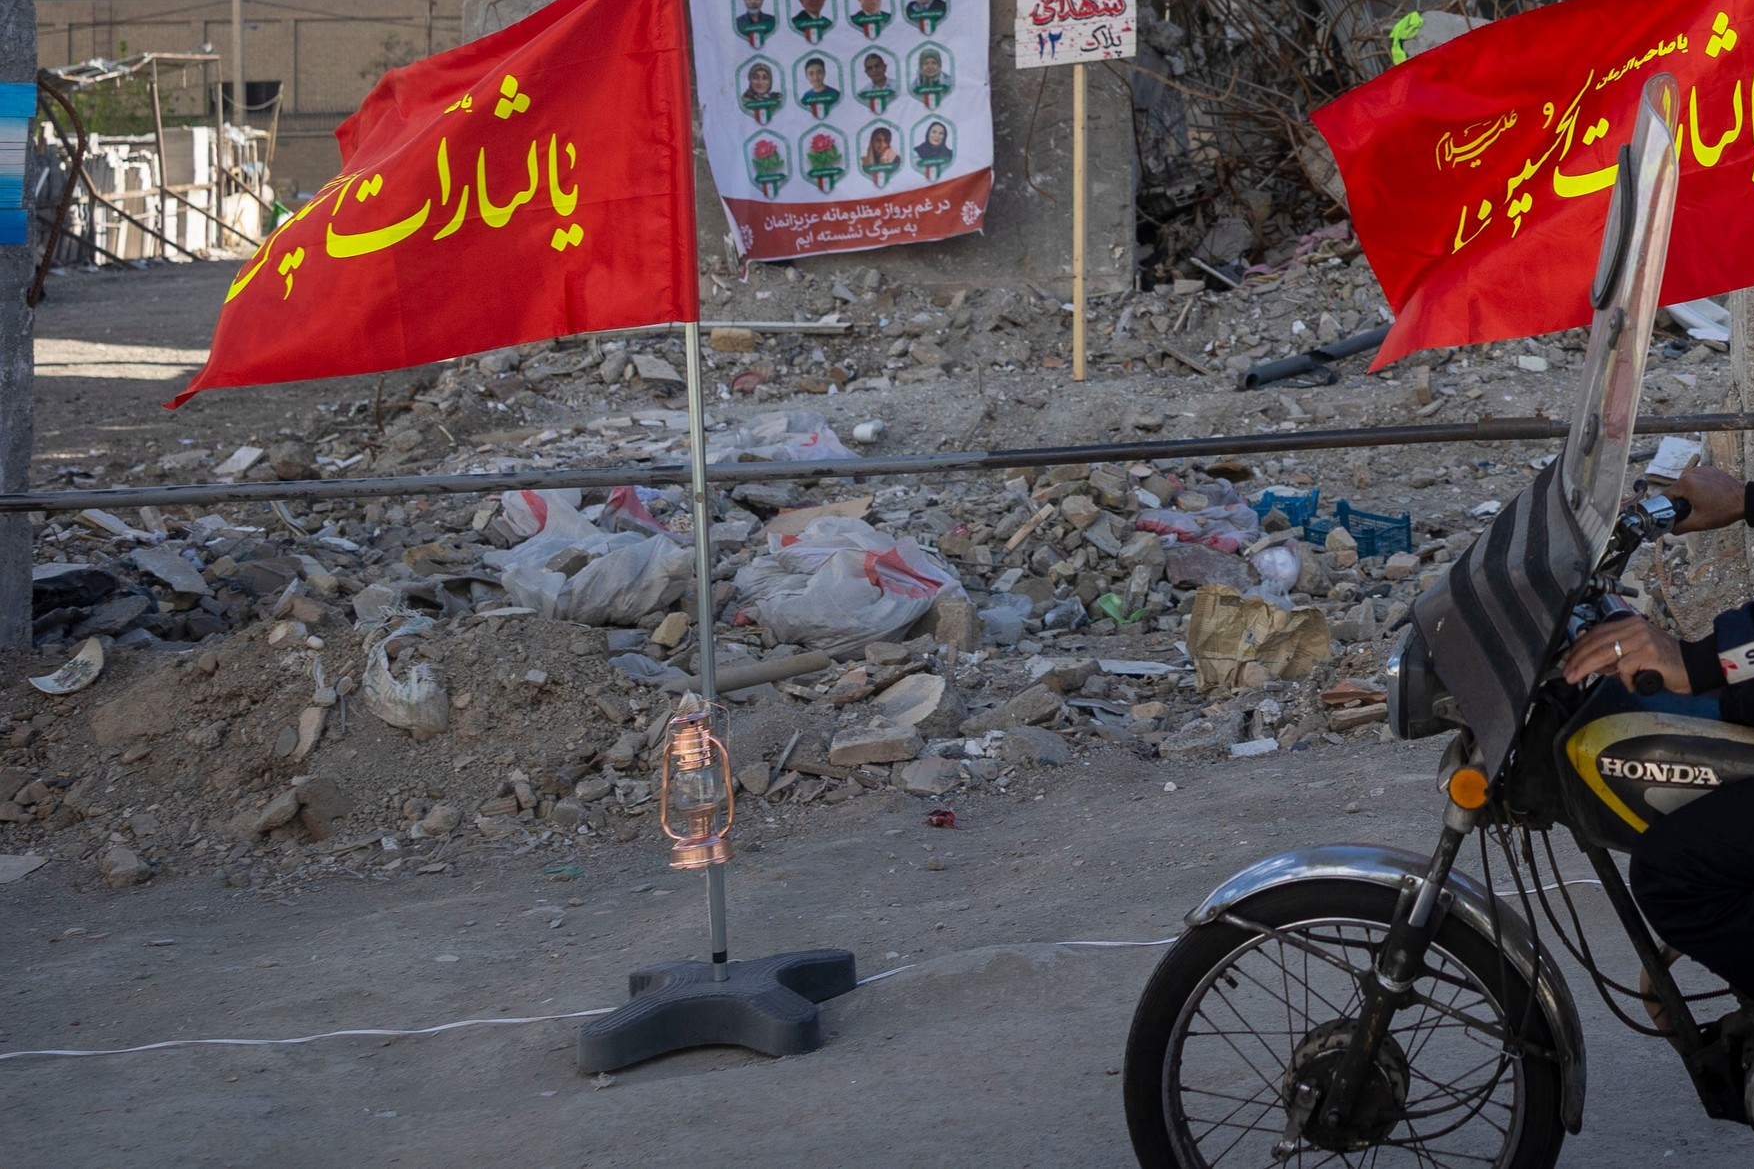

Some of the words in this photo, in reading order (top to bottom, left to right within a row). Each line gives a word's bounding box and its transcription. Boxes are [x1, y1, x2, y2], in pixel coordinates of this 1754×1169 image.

[1080, 24, 1123, 58] پلاک
[822, 202, 882, 226] مظلومانه
[882, 201, 913, 221] پرواز
[914, 199, 934, 219] غم
[934, 198, 951, 215] در
[763, 212, 821, 232] عزیزانمان
[865, 220, 901, 241] سوگ
[902, 222, 918, 238] به
[794, 230, 815, 251] ایم
[816, 224, 864, 243] نشسته
[1600, 757, 1723, 786] HONDA
